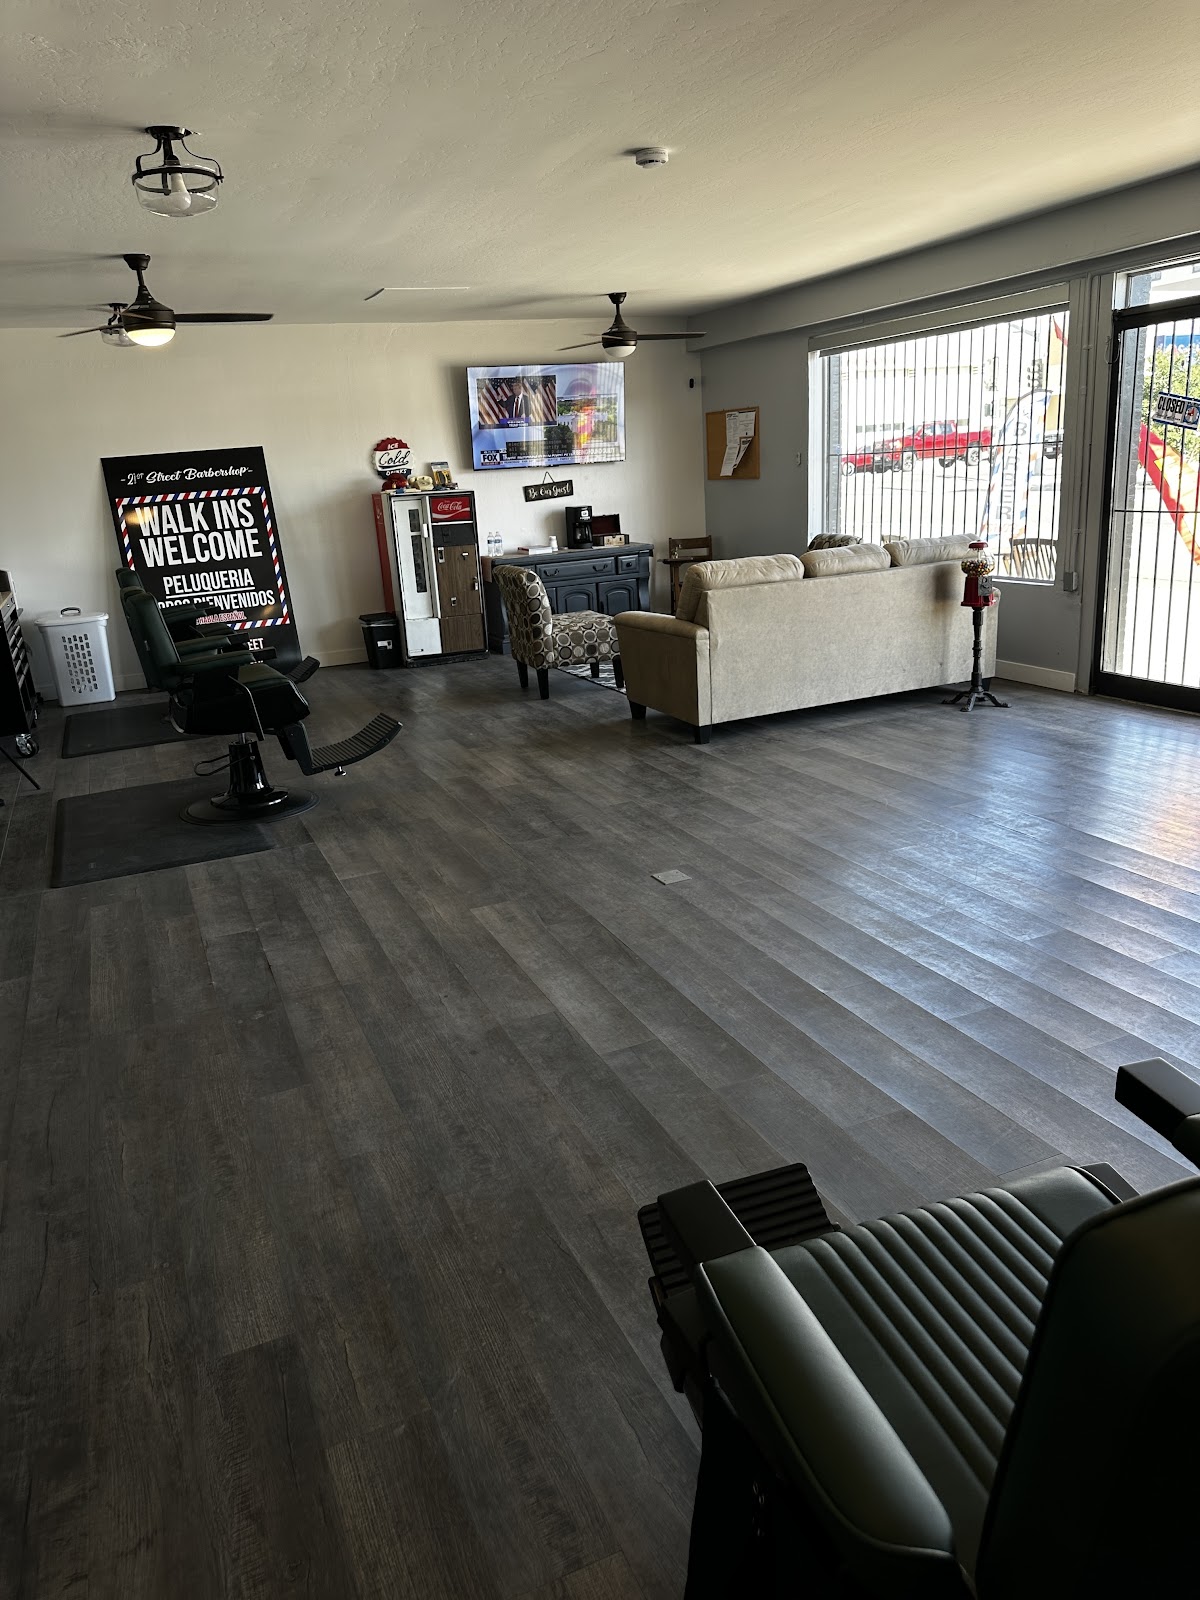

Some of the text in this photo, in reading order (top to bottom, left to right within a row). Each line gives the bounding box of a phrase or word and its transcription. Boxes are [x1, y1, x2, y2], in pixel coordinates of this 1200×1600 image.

[1158, 396, 1185, 414] CLOSED
[387, 442, 399, 450] ICE
[379, 450, 410, 466] Cold
[483, 454, 497, 462] FOX
[146, 471, 182, 484] Street
[528, 487, 538, 499] Be
[540, 486, 552, 496] Our
[135, 497, 255, 537] WALK INS
[139, 528, 262, 568] WELCOME
[163, 568, 254, 594] PELUQUERIA
[193, 590, 275, 610] NVENIDOS
